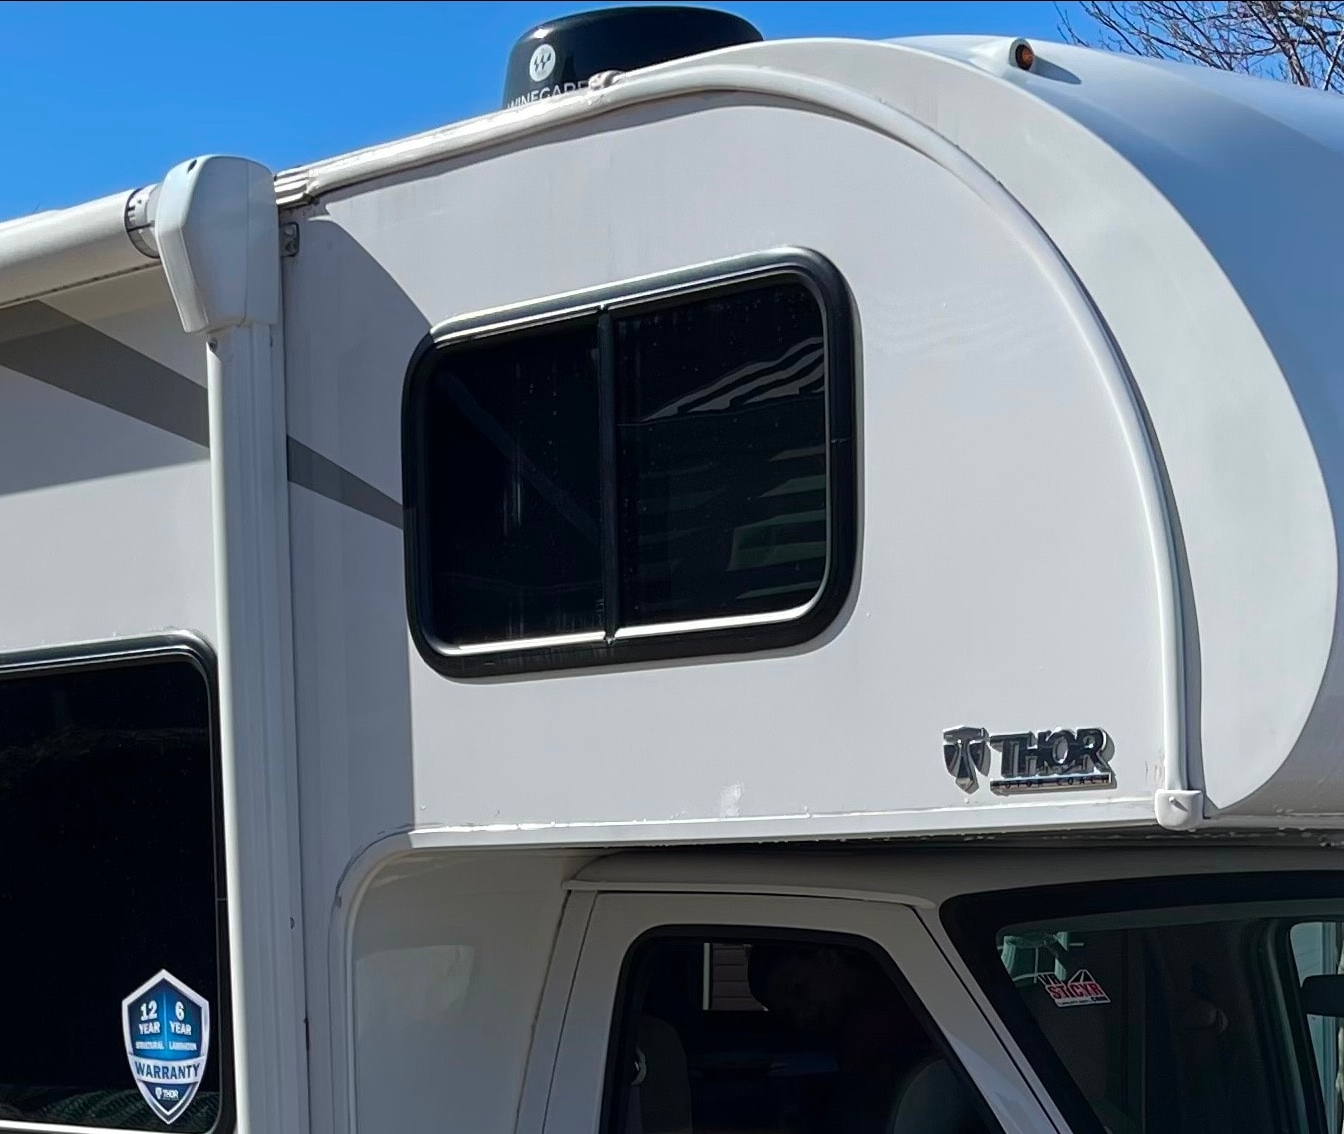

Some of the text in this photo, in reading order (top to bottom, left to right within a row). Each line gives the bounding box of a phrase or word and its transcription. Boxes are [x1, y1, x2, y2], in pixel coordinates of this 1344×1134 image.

[989, 727, 1114, 779] THOR
[140, 1000, 158, 1020] 12
[174, 1001, 185, 1020] 6
[138, 1021, 161, 1035] YEAR
[169, 1021, 192, 1036] YEAR
[134, 1061, 200, 1080] WARRANTY
